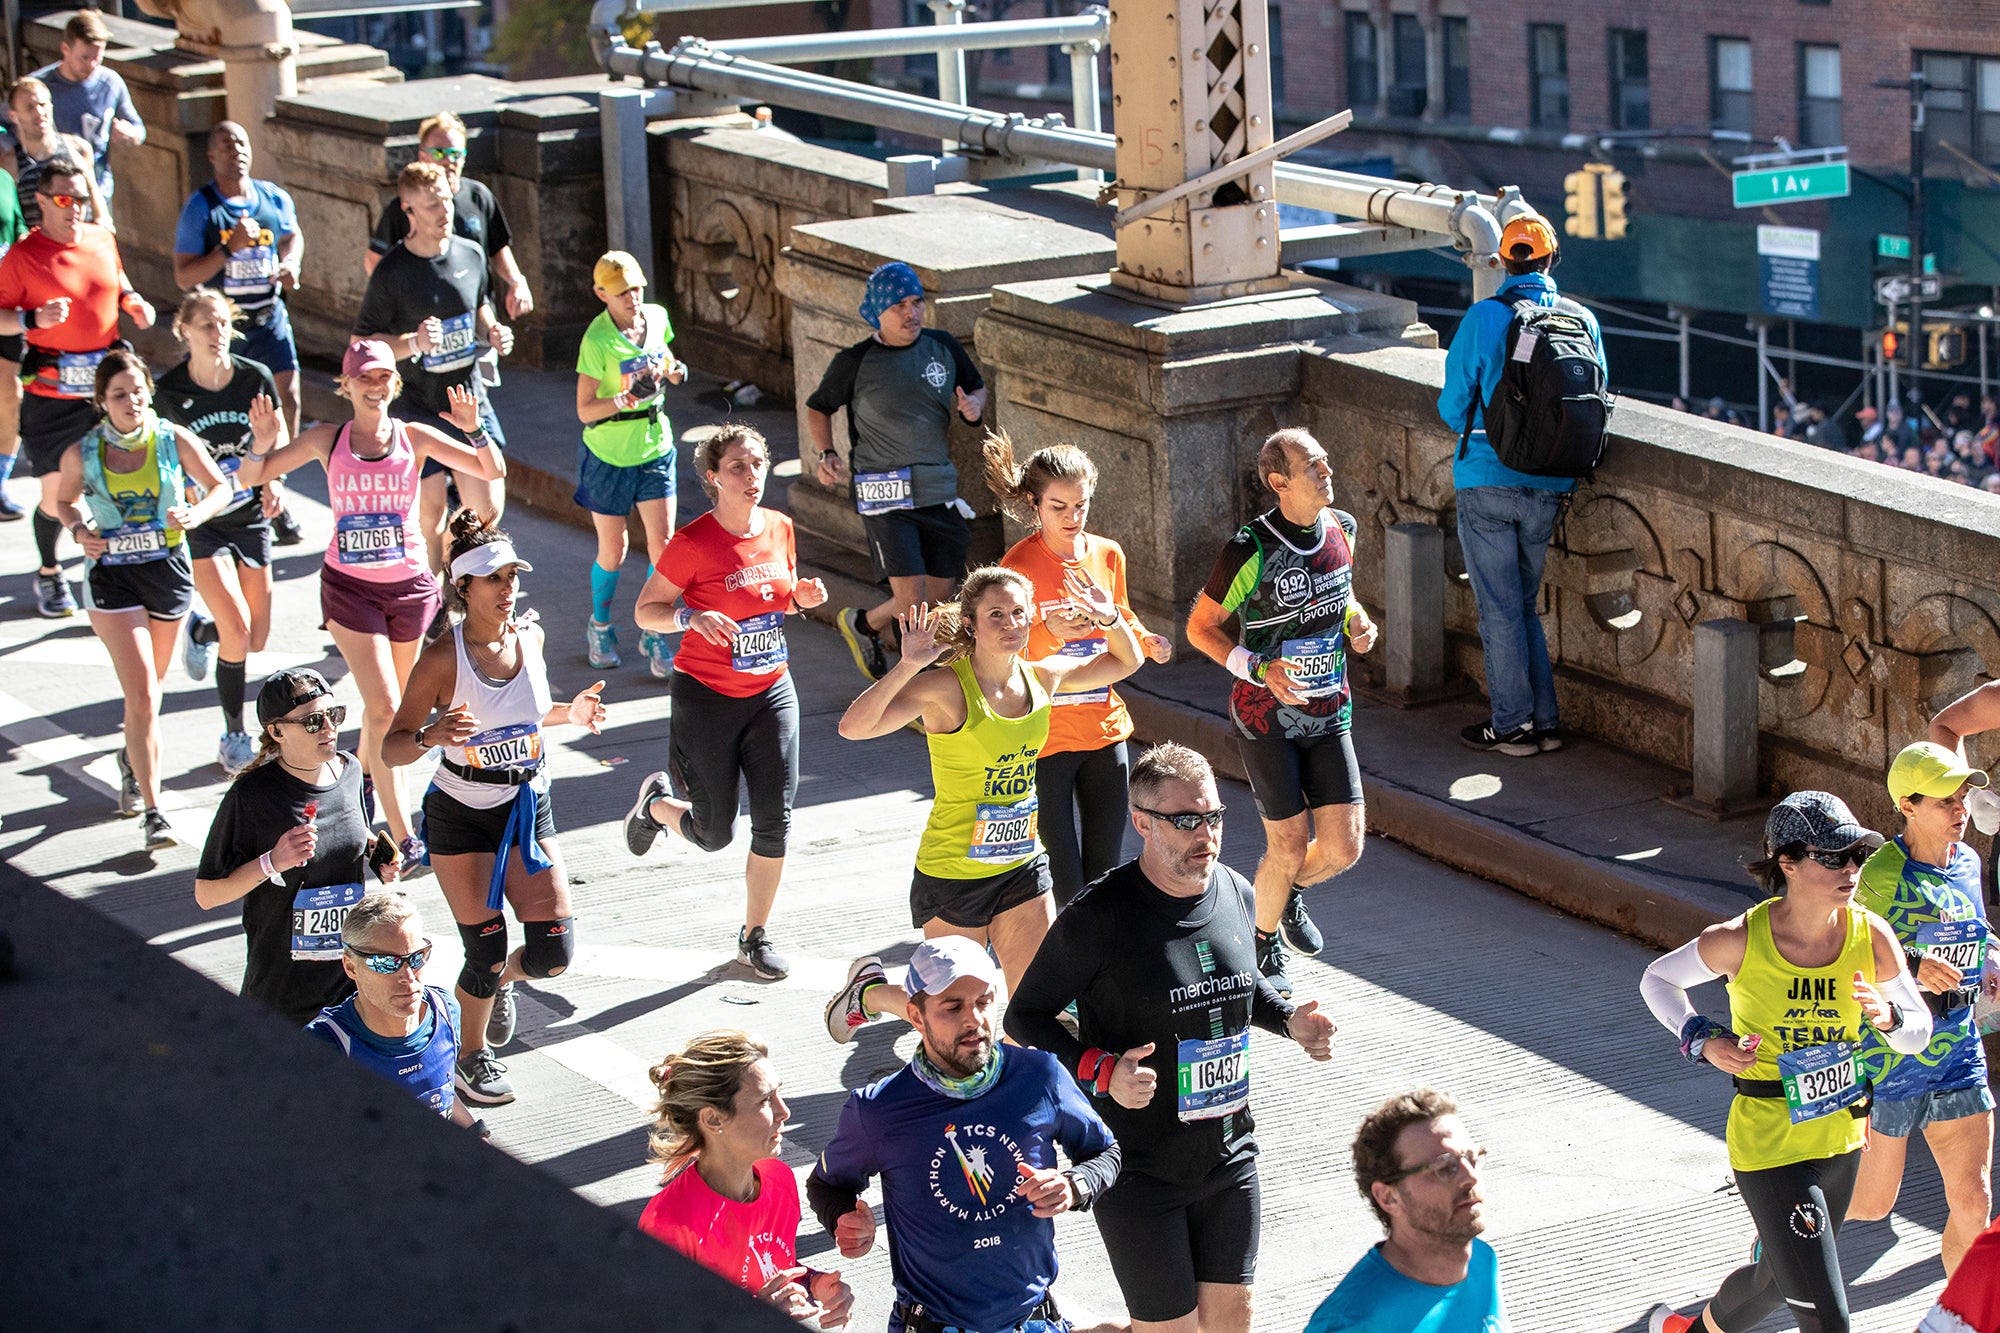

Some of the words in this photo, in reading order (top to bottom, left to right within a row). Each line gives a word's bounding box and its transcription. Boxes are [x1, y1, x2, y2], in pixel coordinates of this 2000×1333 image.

[1138, 124, 1164, 170] 15
[1771, 176, 1779, 194] 1
[1785, 174, 1810, 192] Av
[188, 410, 249, 434] INNESO
[336, 473, 410, 492] JADEUS
[865, 482, 899, 500] 22837
[334, 494, 412, 513] MAXIMUS
[116, 533, 152, 552] 22115
[351, 529, 390, 550] 21766
[480, 738, 528, 766] 30074
[985, 761, 1036, 780] TEAM
[975, 828, 982, 840] 2
[985, 818, 1028, 842] 29682
[294, 916, 302, 930] 2
[310, 908, 349, 934] 2480
[1170, 970, 1253, 1003] merchants
[1787, 977, 1836, 1000] JANE
[1178, 1000, 1210, 1012] DIMENSION
[1212, 996, 1227, 1004] DATA
[1228, 991, 1253, 1000] COMPANY
[1774, 1026, 1846, 1042] TEAM
[1196, 1042, 1226, 1054] CONSULTANCY
[1202, 1049, 1221, 1058] SERVICES
[1783, 1042, 1791, 1054] OR
[1805, 1048, 1821, 1057] TATA
[1838, 1050, 1850, 1058] TATA
[1796, 1051, 1832, 1066] CONSULTANCY
[1805, 1059, 1828, 1070] SERVICES
[398, 1064, 418, 1076] CRAFT
[1198, 1054, 1241, 1090] 16437
[1788, 1086, 1798, 1100] 2
[1803, 1061, 1851, 1100] 32812
[1857, 1062, 1864, 1076] B
[963, 1124, 996, 1138] TCS
[998, 1134, 1024, 1162] NEW
[929, 1146, 969, 1220] MARATHON
[1005, 1169, 1025, 1204] ORK
[974, 1203, 1006, 1222] CITY
[973, 1236, 1001, 1250] 2018
